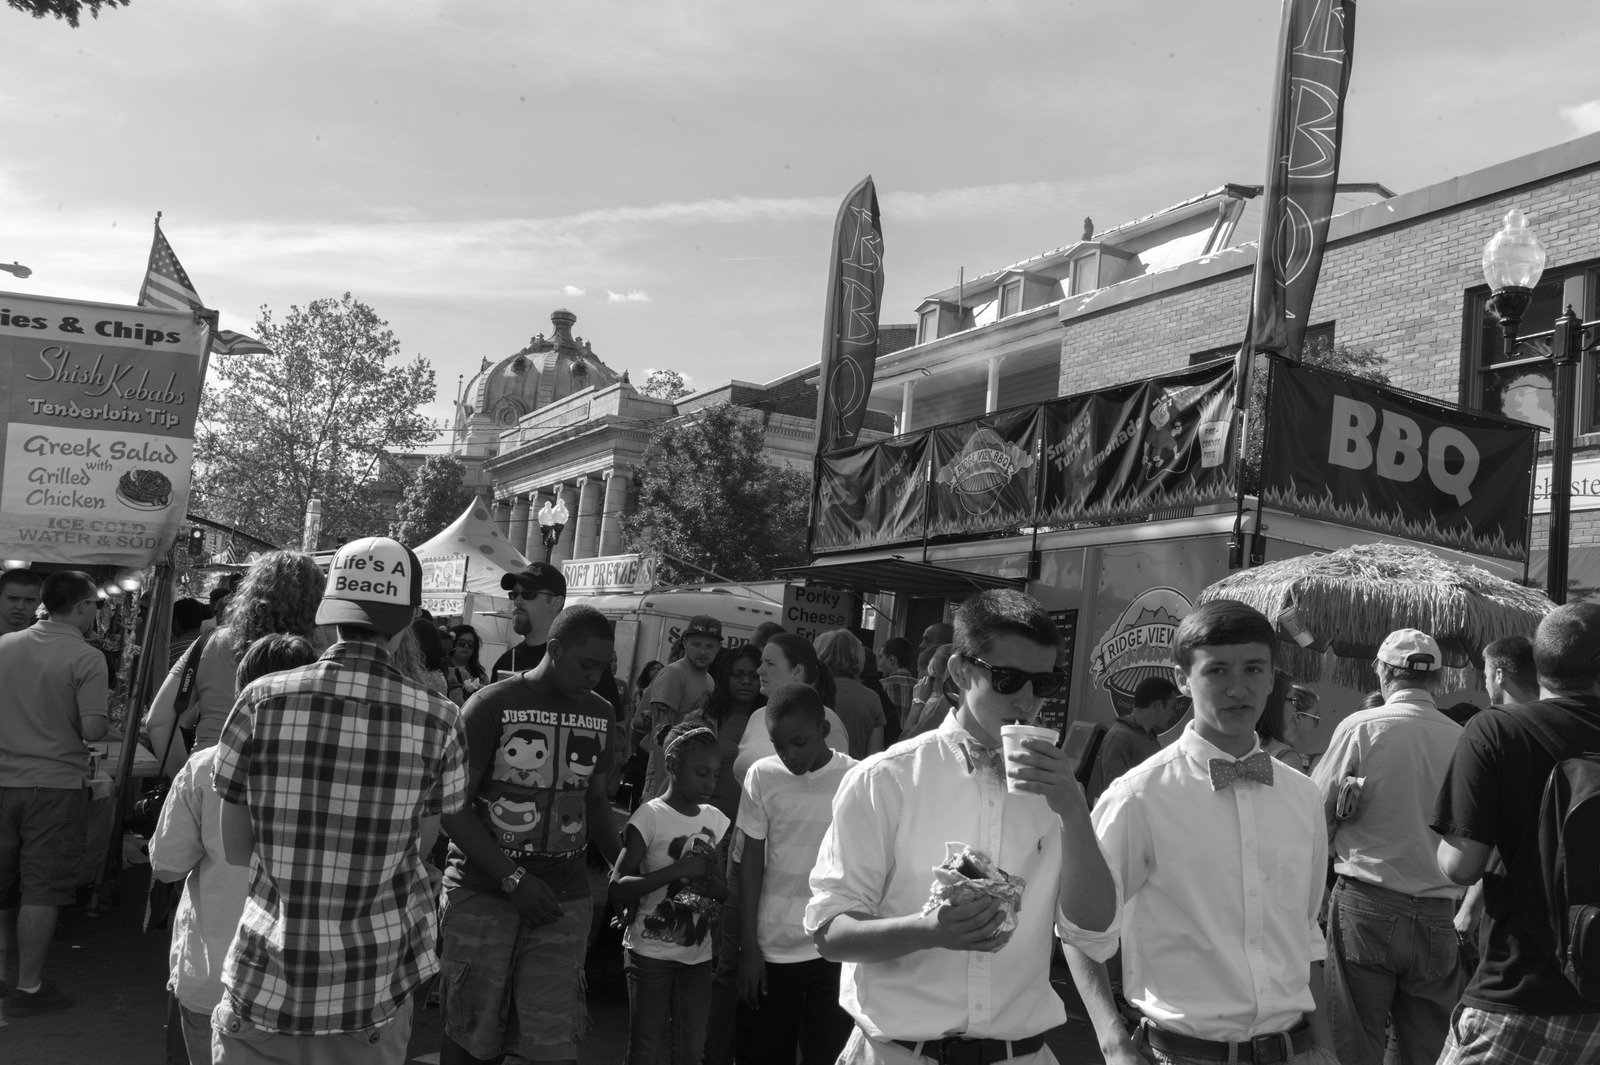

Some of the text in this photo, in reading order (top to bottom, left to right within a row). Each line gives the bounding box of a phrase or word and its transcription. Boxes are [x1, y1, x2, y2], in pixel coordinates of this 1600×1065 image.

[0, 308, 181, 345] ies & Chips
[26, 346, 185, 405] Shish Kebabs
[28, 398, 180, 428] Tenderloin Tip
[1047, 411, 1091, 460] Smoked
[23, 435, 178, 464] Greek Salad
[1054, 432, 1091, 472] Turkey
[1082, 417, 1142, 477] Lemonade
[1328, 394, 1480, 507] BBQ
[86, 460, 113, 472] with
[994, 452, 1010, 467] BBQ
[28, 467, 91, 485] Grilled
[25, 489, 106, 509] Chicken
[47, 517, 84, 531] ICE
[19, 528, 90, 545] WATER
[99, 535, 110, 546] &
[334, 555, 406, 577] Life's A
[564, 564, 590, 588] SOFT
[592, 559, 653, 587] PRETZELS
[335, 576, 397, 597] Beach
[796, 588, 840, 608] Porky
[788, 607, 845, 626] Cheese
[796, 628, 817, 644] Fri
[1107, 629, 1143, 659] RIDGE
[182, 668, 194, 692] Canon
[502, 710, 608, 731] JUSTICE LEAGUE
